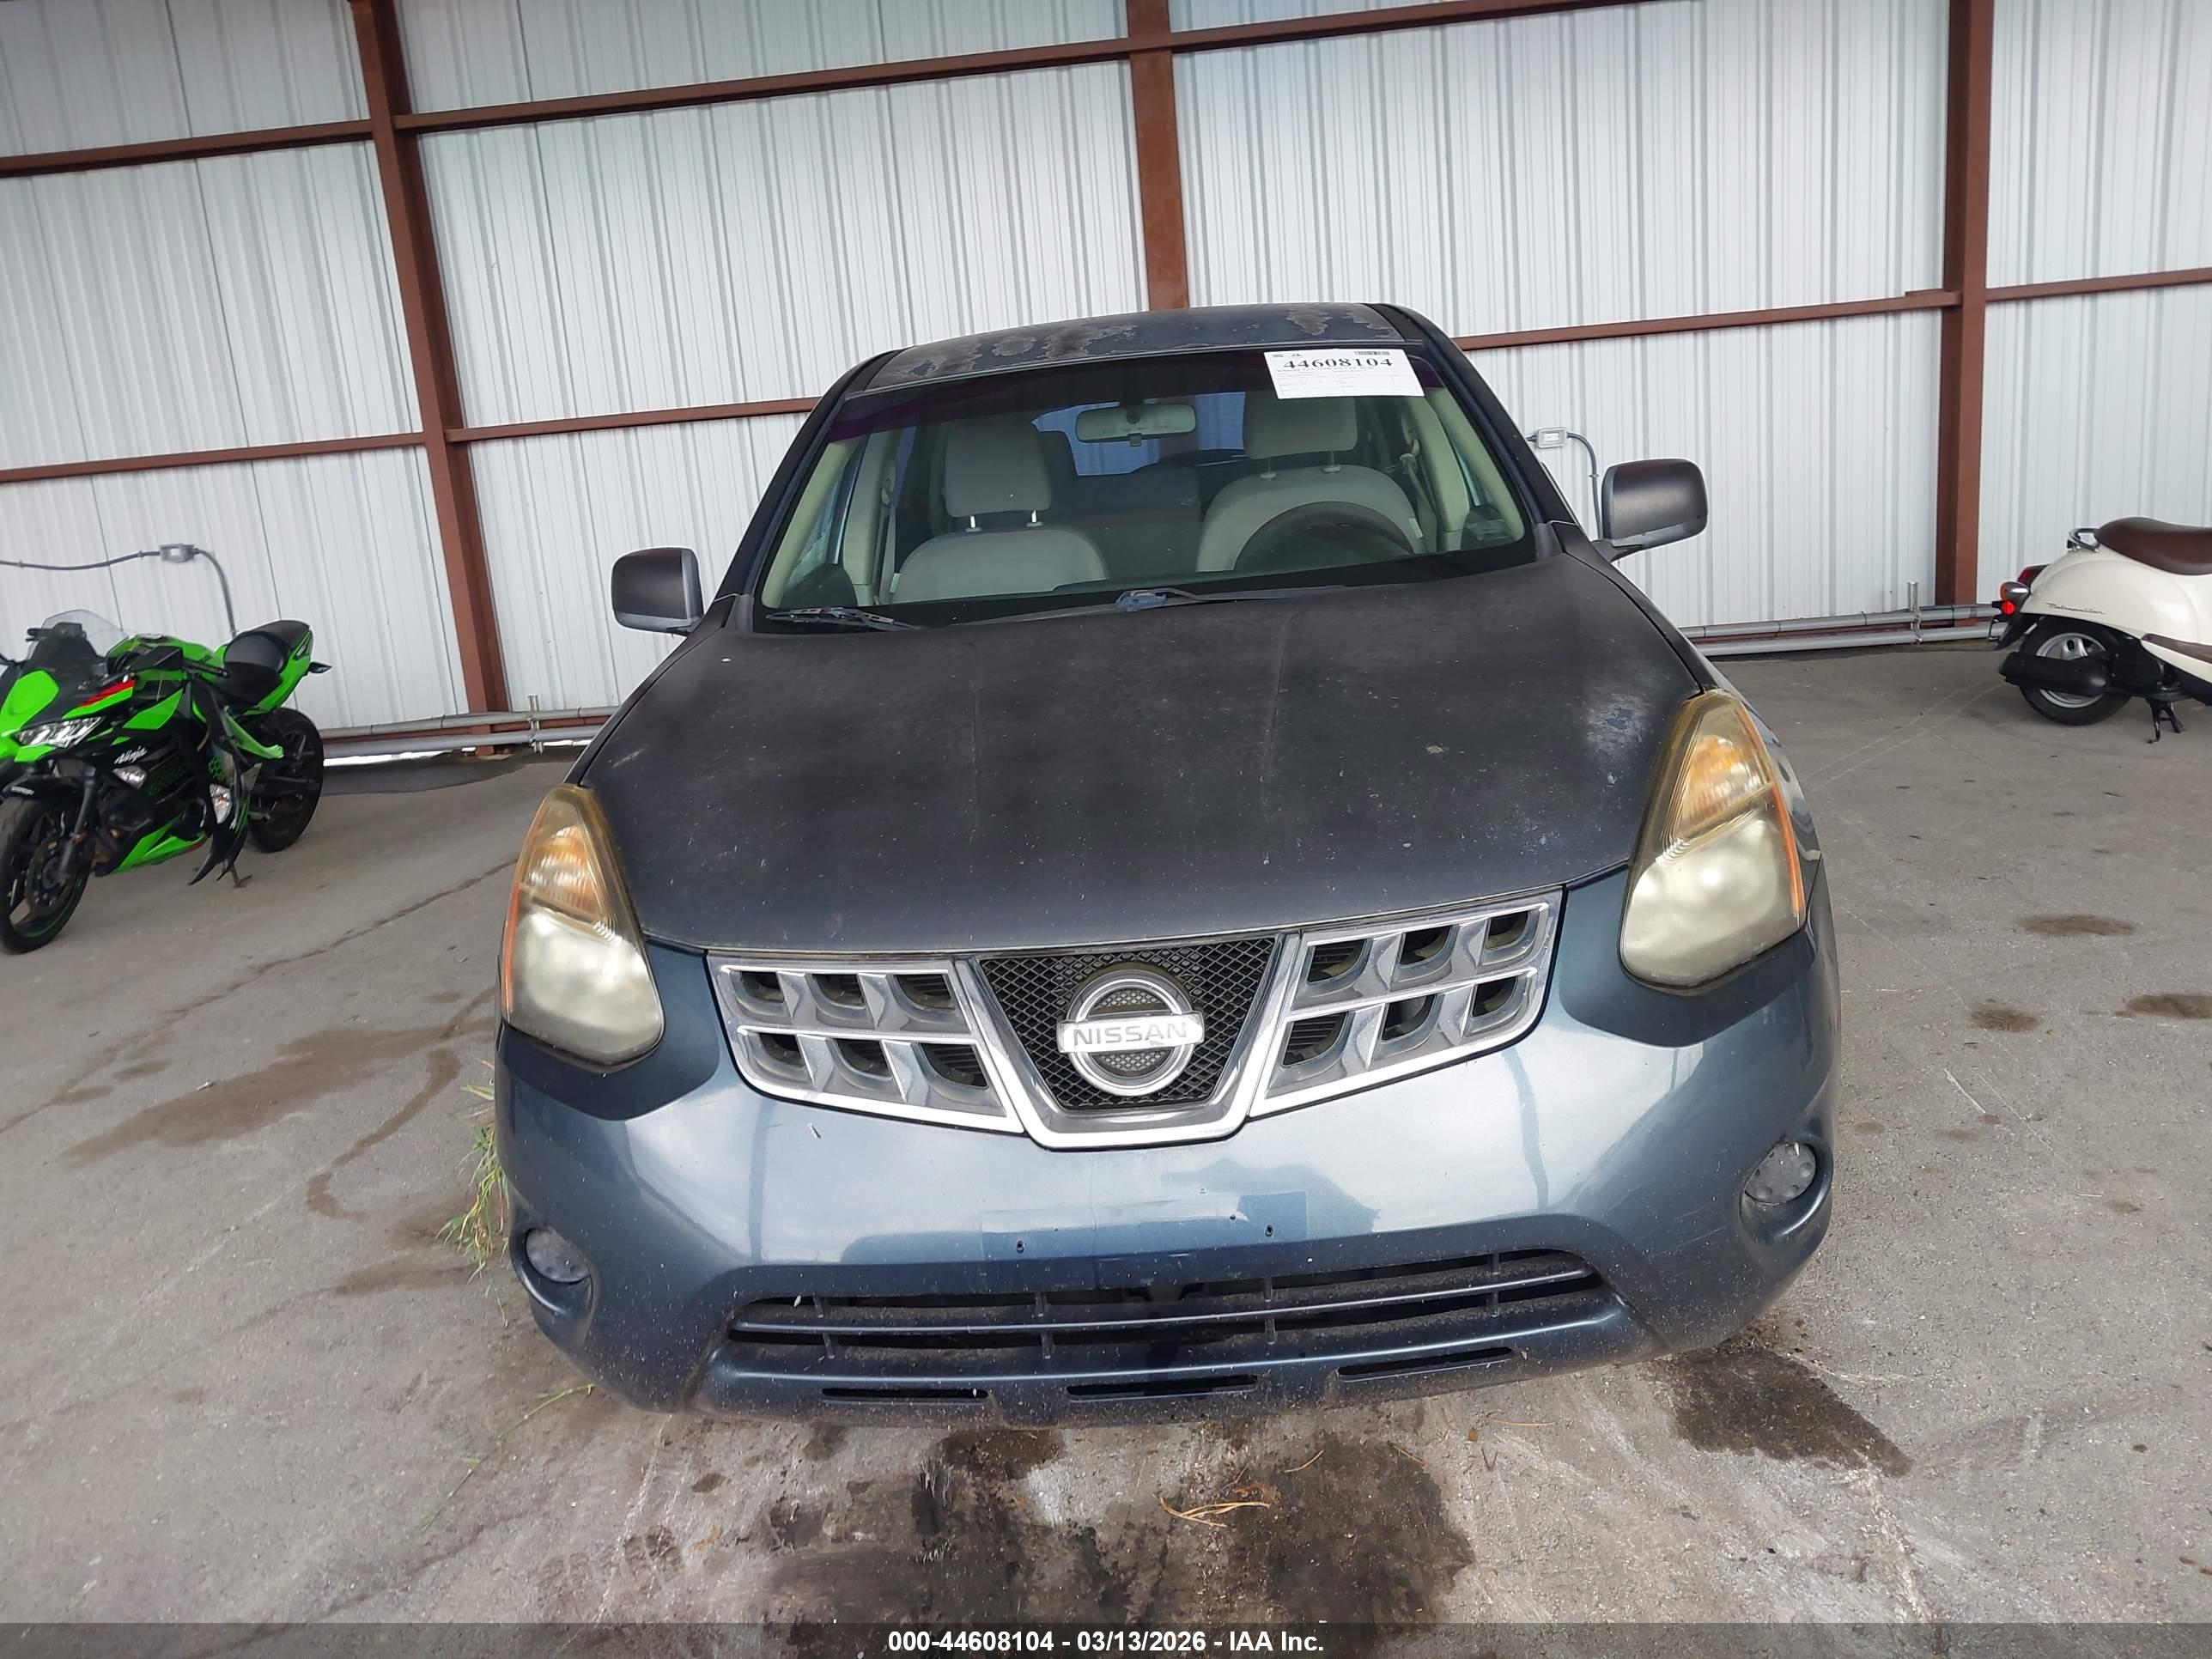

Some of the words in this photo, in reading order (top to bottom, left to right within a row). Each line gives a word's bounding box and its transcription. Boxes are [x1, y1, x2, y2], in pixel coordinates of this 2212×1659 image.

[1284, 358, 1393, 369] 44608104
[113, 745, 147, 764] Ninja
[1073, 1022, 1188, 1046] NISSAN
